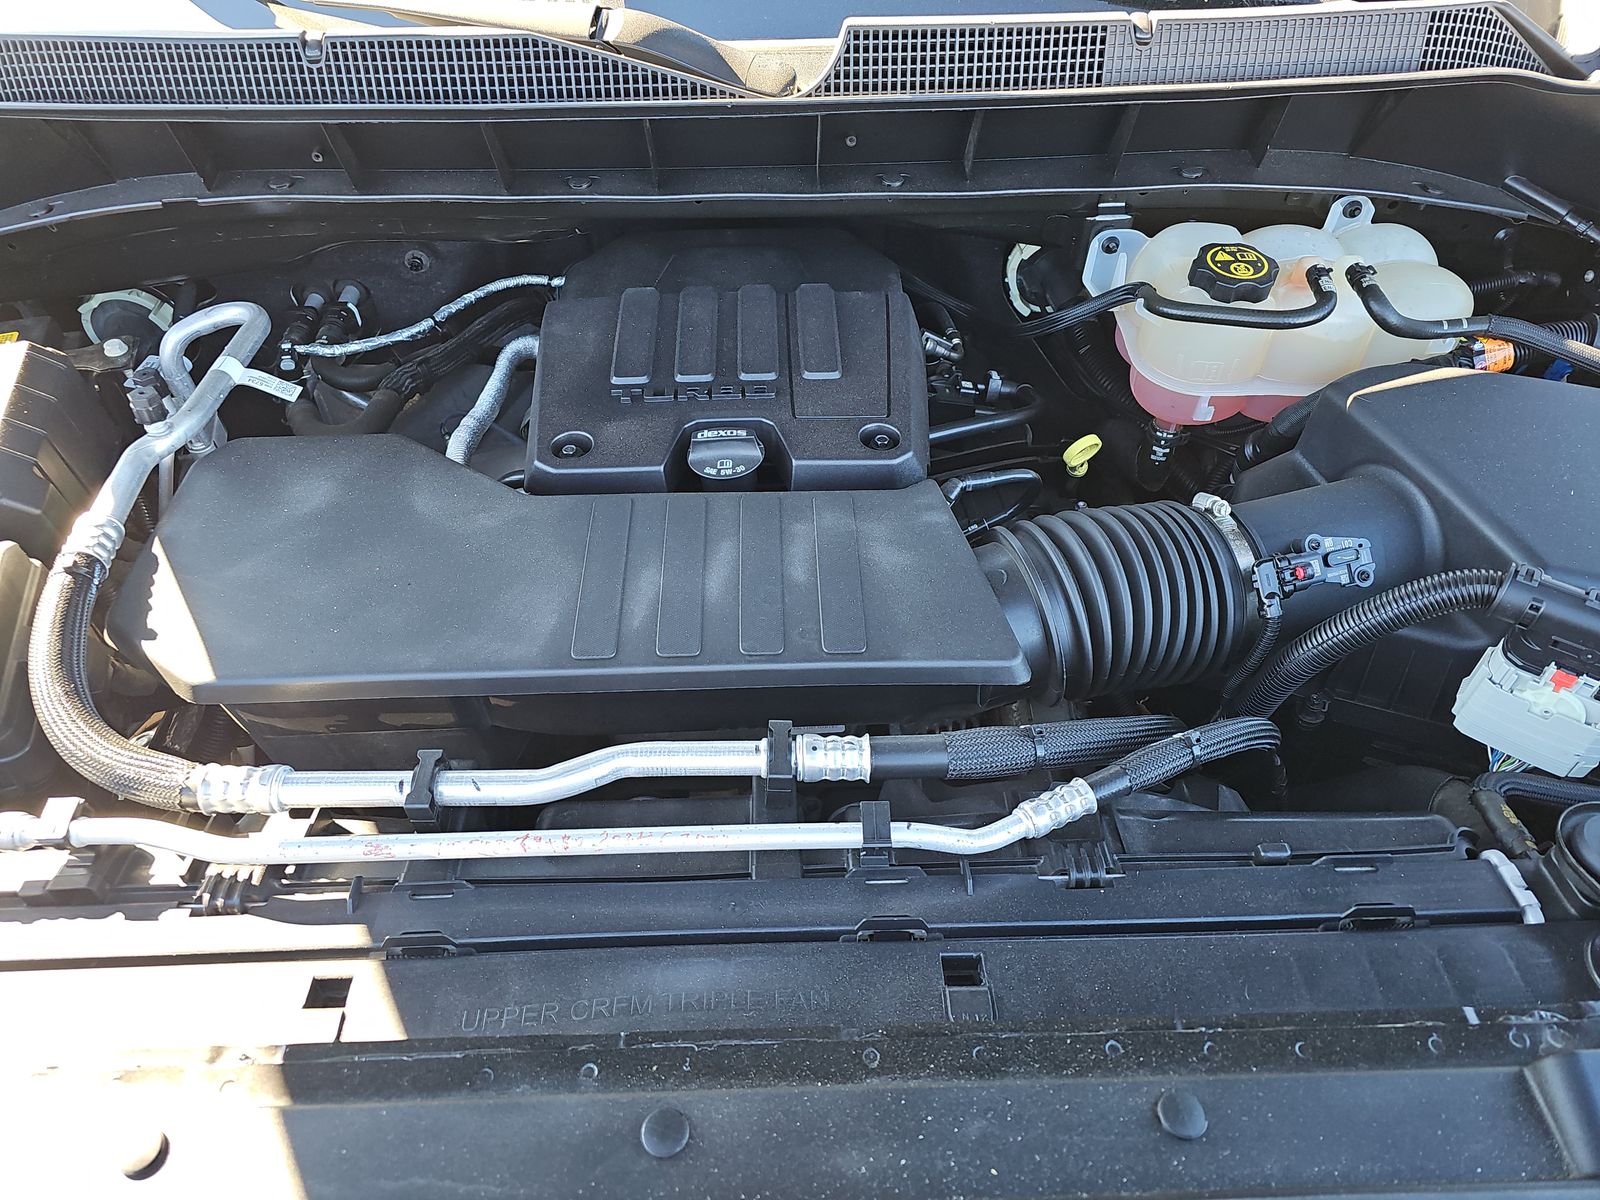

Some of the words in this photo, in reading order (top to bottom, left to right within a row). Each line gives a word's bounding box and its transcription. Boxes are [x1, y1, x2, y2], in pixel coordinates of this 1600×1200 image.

[610, 385, 776, 404] TURBO
[697, 429, 746, 438] dexos
[703, 466, 718, 476] SAE
[720, 464, 746, 476] 5W-30
[461, 1002, 560, 1032] UPPER
[570, 995, 653, 1021] CRFM
[662, 988, 765, 1012] TRIPLE
[775, 989, 830, 1010] FAN
